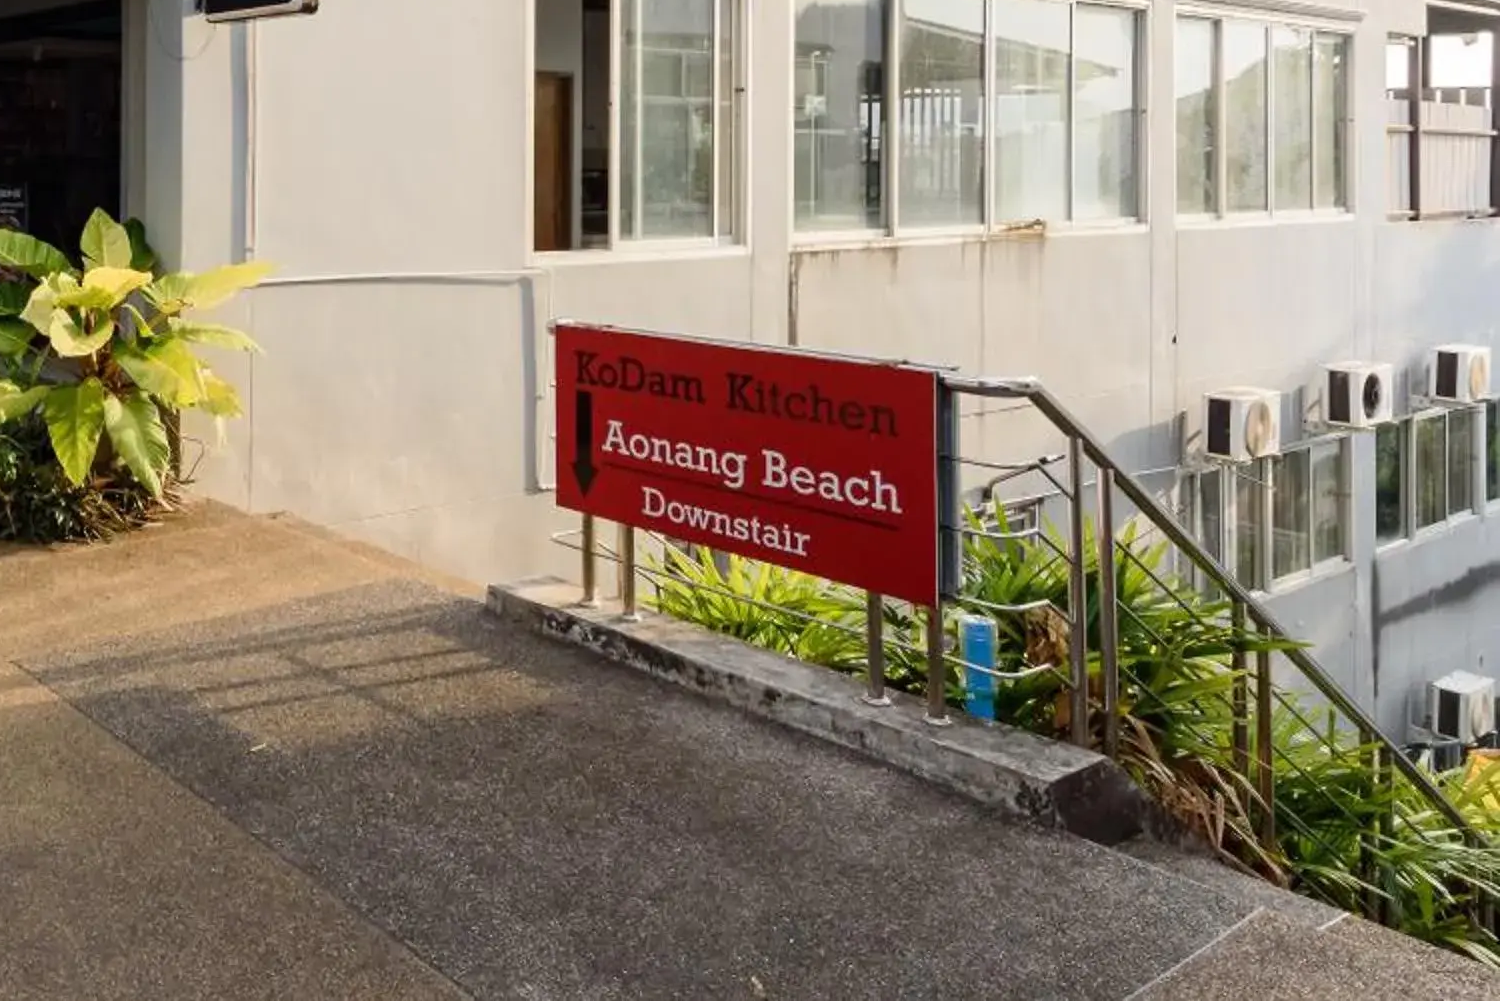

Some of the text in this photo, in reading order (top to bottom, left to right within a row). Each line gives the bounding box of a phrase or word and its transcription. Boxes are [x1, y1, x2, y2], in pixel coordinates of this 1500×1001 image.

[575, 350, 899, 439] KoDam Kitchen
[601, 419, 903, 514] Aonang Beach
[641, 486, 812, 557] Downstair
